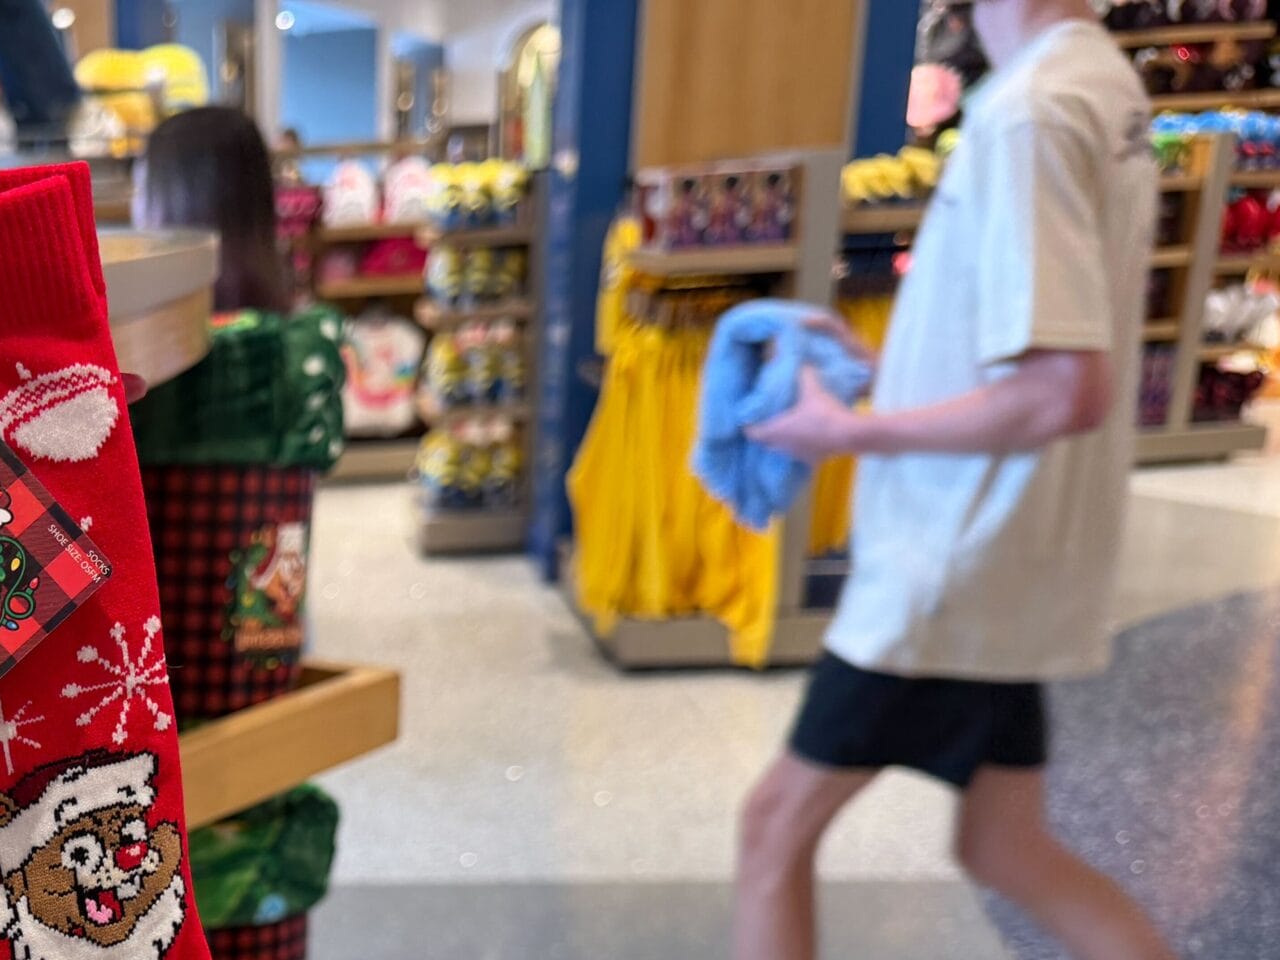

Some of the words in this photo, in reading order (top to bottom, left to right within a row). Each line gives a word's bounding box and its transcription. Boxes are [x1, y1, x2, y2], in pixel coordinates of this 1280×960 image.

[47, 524, 69, 546] SHOE
[65, 543, 82, 563] SIZE:
[80, 561, 101, 583] OSFM
[87, 550, 110, 575] SOCKS
